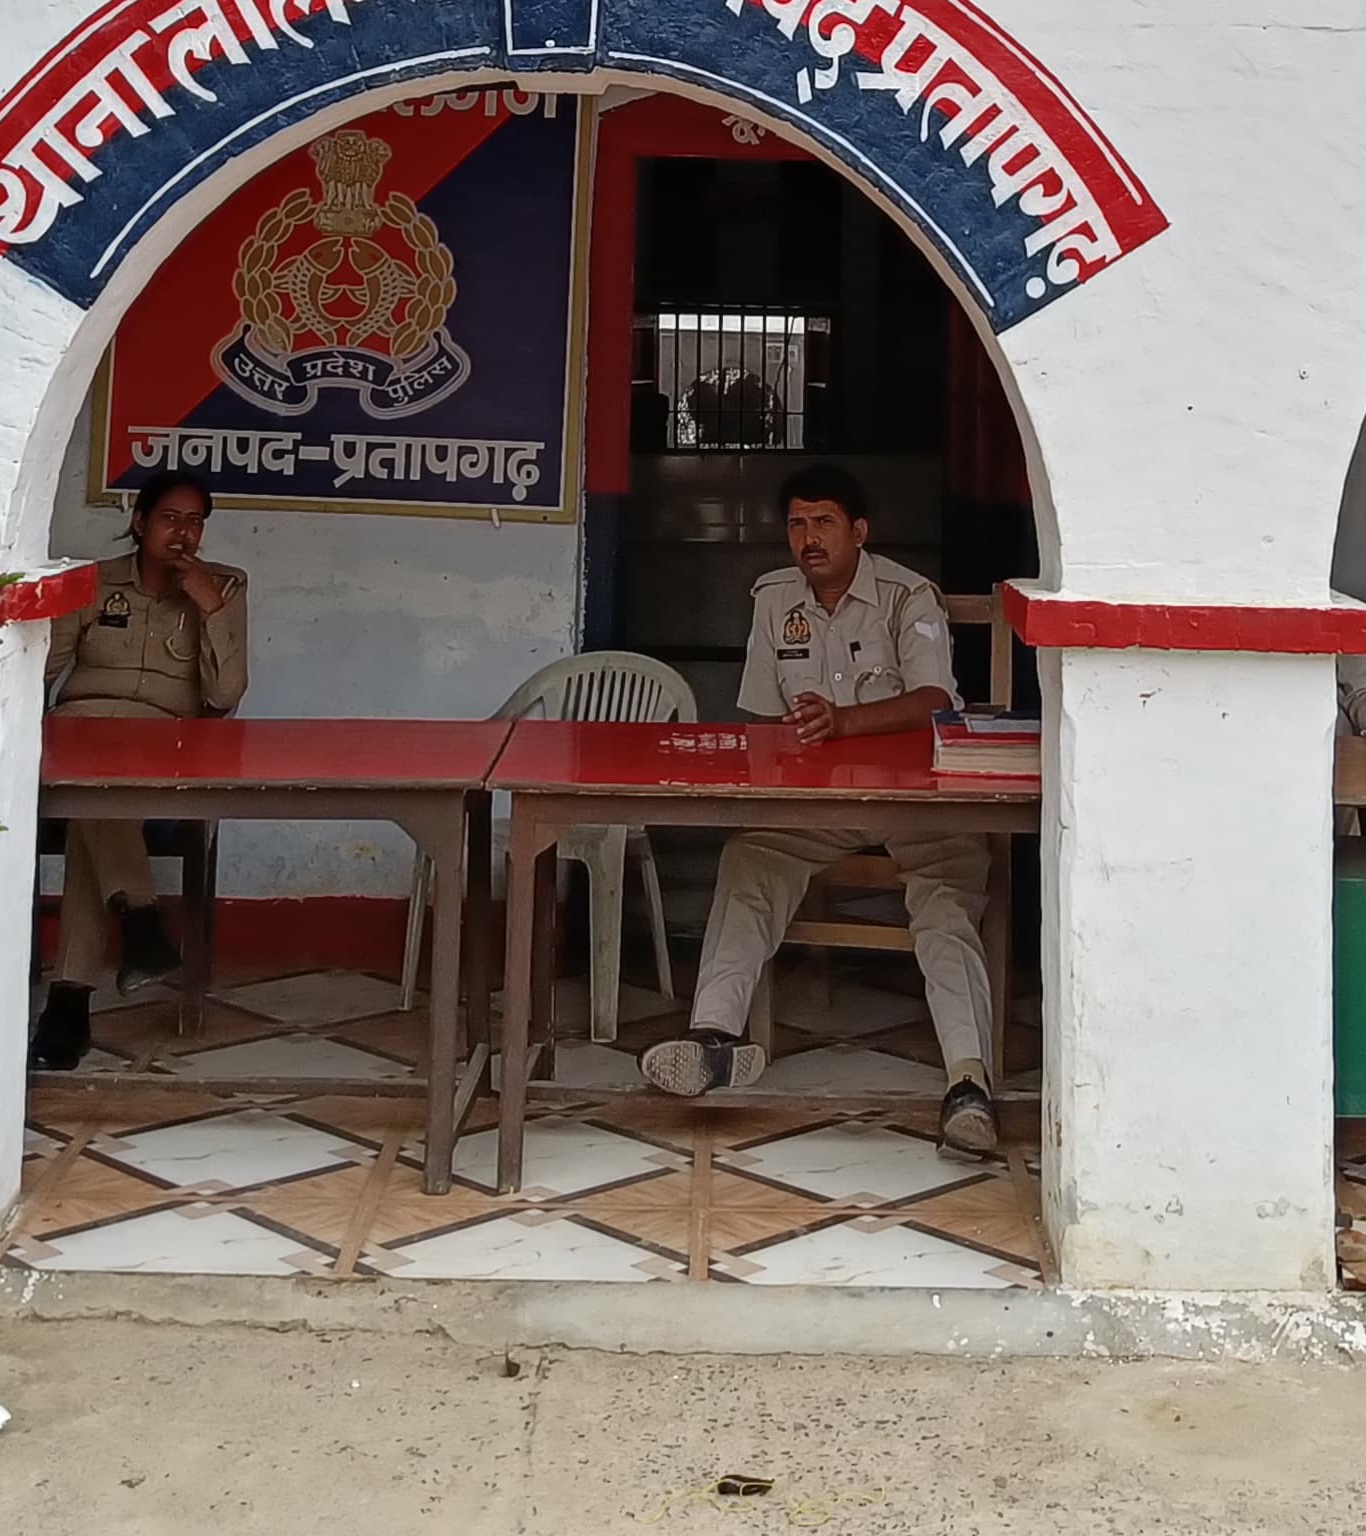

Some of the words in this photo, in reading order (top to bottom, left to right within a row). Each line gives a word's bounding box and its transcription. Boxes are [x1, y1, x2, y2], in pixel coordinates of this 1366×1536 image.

[233, 352, 291, 402] उत्तर
[302, 351, 377, 383] प्रदेश
[385, 355, 454, 407] पुलिस
